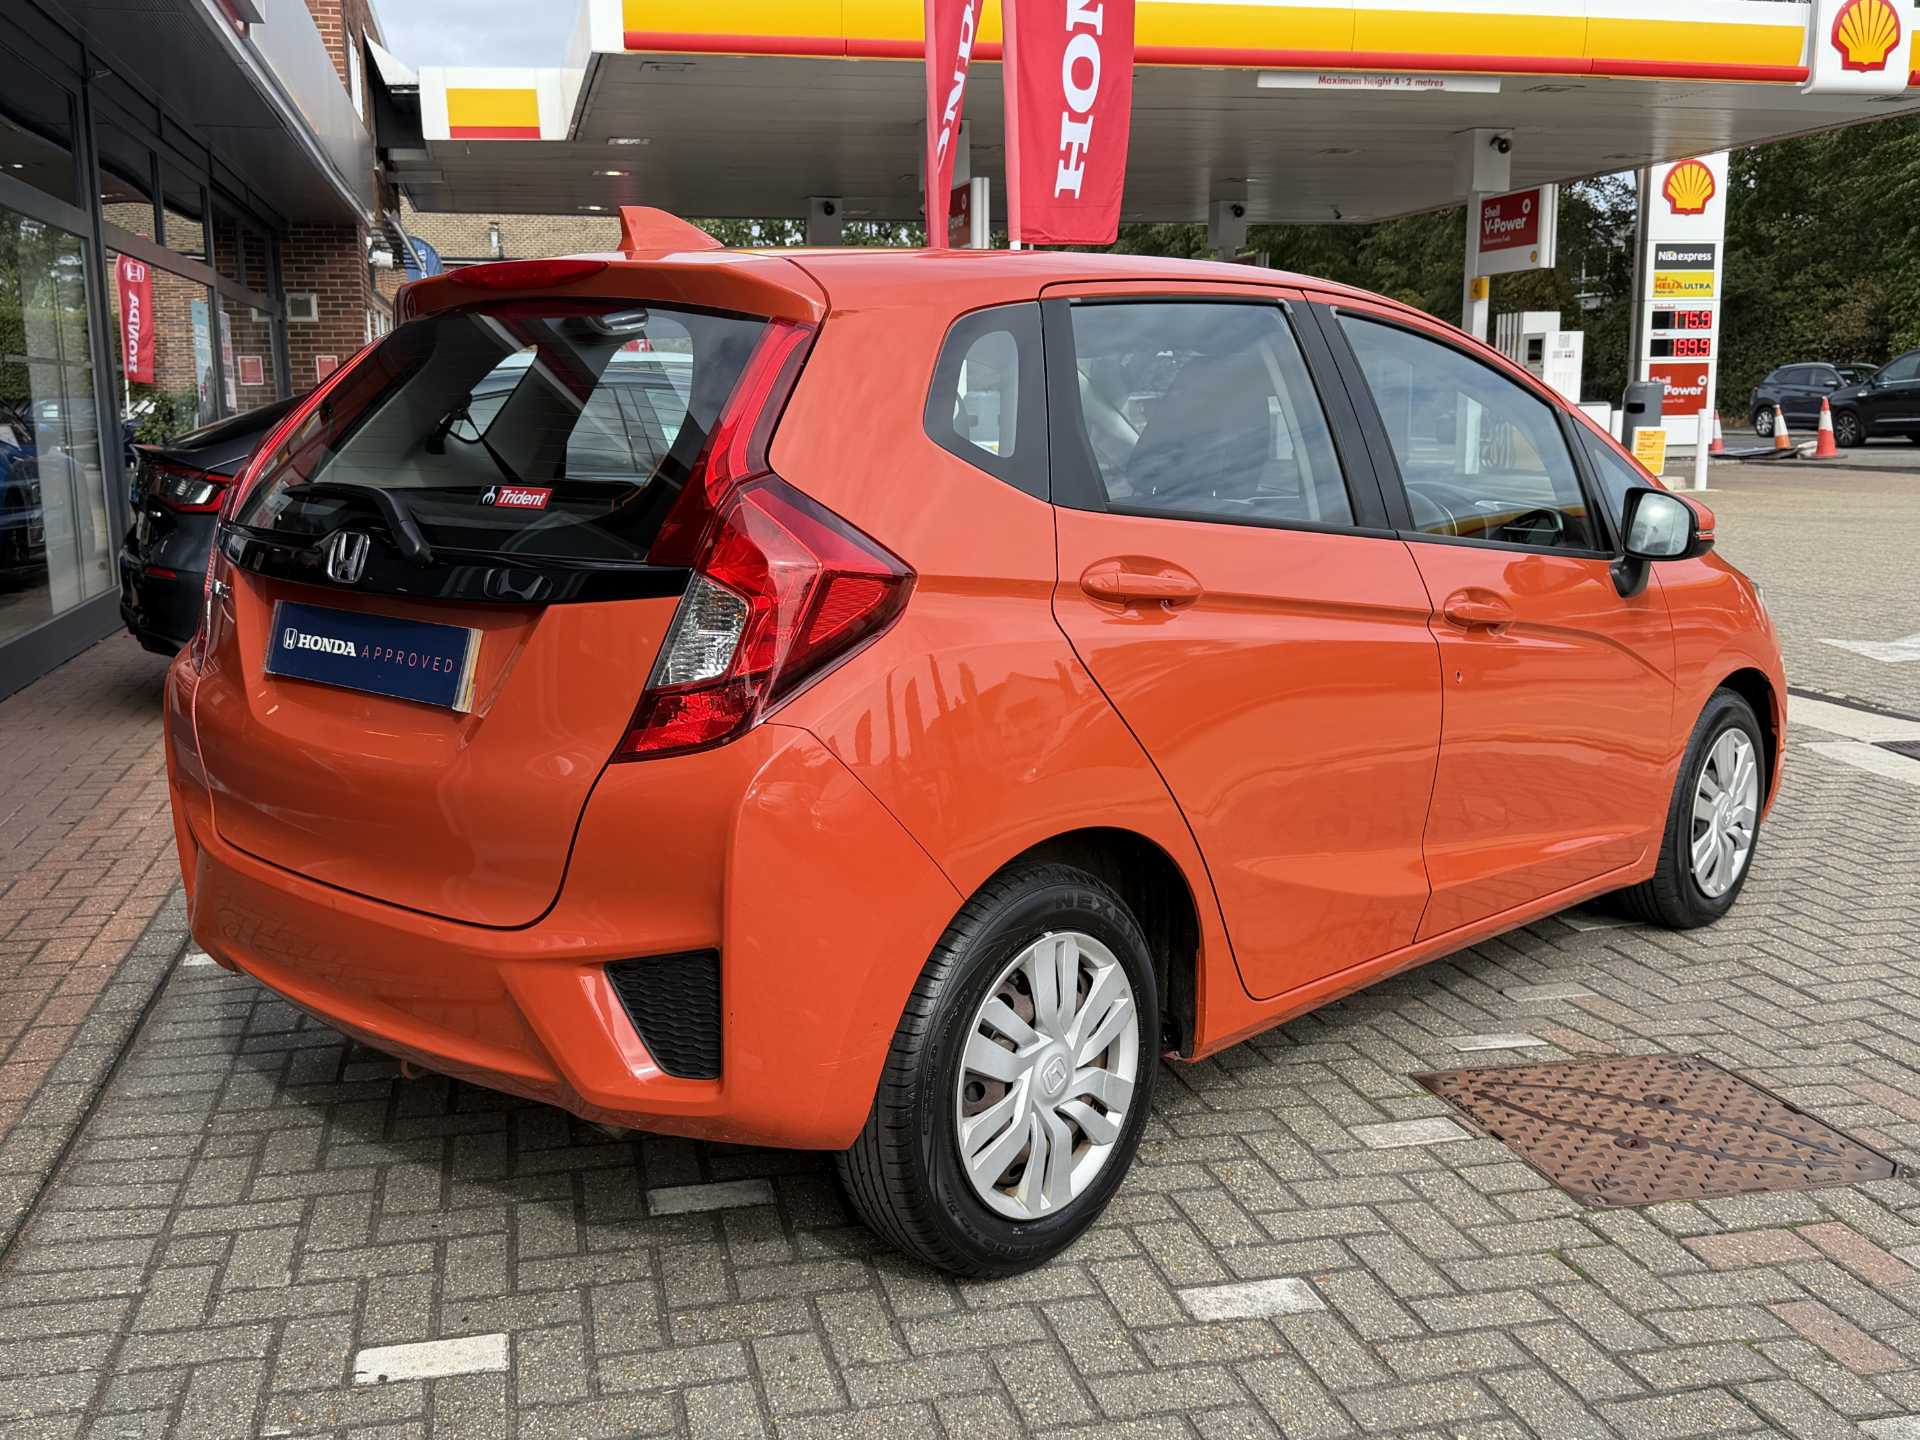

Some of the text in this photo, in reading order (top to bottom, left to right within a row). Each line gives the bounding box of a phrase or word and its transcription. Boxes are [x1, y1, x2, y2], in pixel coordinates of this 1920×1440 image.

[1318, 75, 1361, 86] Maximum
[1363, 76, 1392, 87] height
[1415, 78, 1444, 87] metres
[1484, 204, 1500, 218] Shell
[1485, 217, 1526, 235] V-Power
[1678, 252, 1712, 263] express
[1675, 311, 1711, 329] 175.9
[1673, 339, 1710, 356] 199.9
[1664, 385, 1703, 396] Power
[500, 489, 546, 506] Trident
[298, 633, 453, 673] HONDA APPROVED
